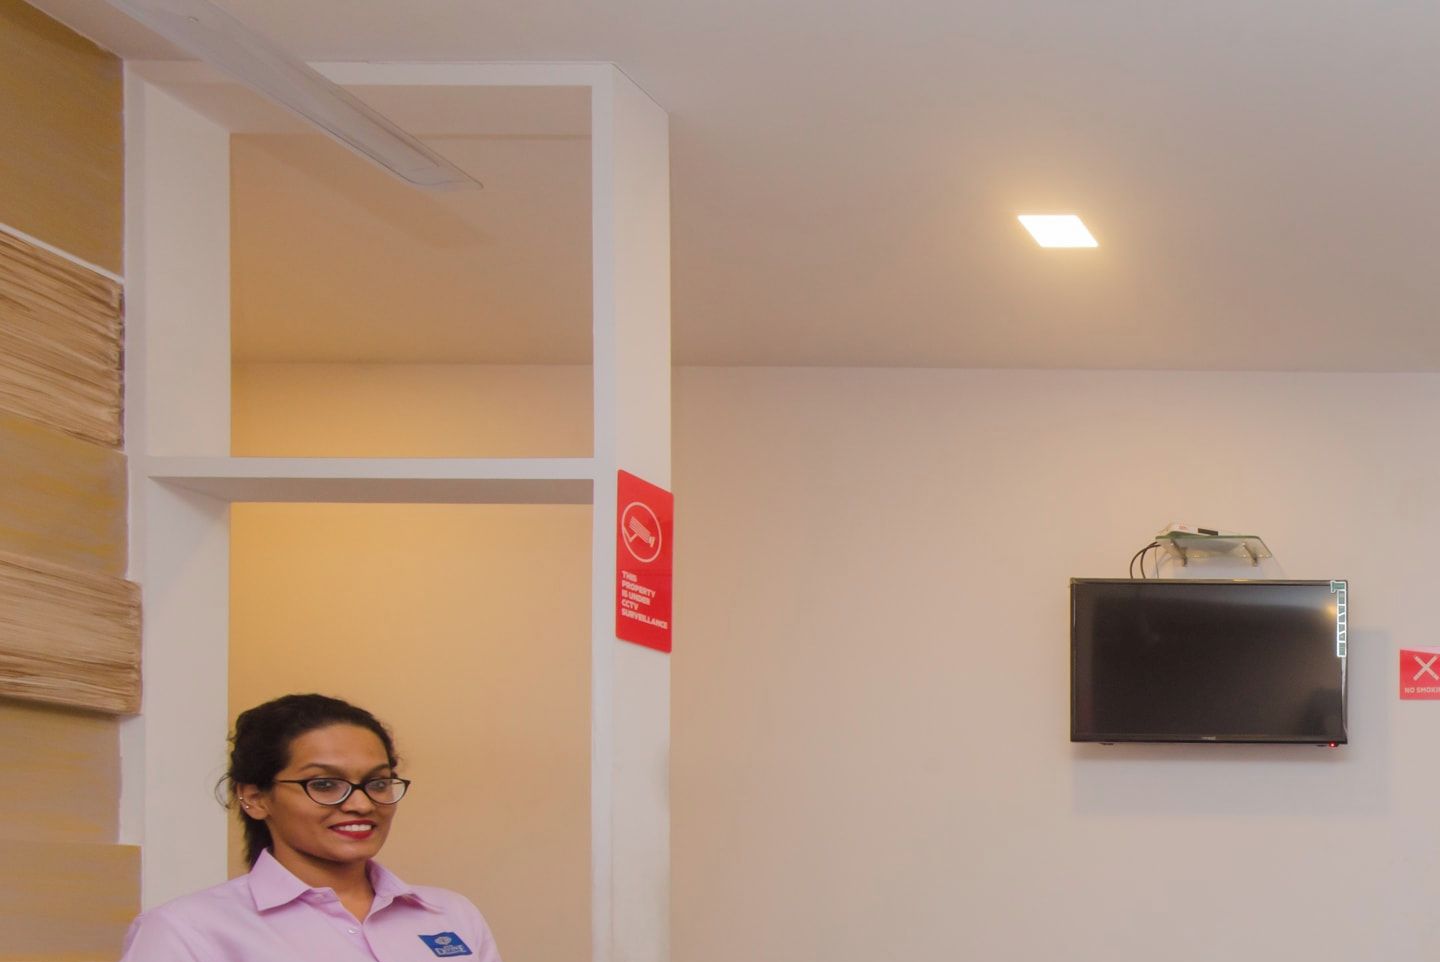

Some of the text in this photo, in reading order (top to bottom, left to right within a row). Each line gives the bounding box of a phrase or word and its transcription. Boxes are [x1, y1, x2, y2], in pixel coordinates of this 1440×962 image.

[622, 580, 656, 598] PROPERTY
[622, 598, 639, 610] CCTV
[622, 608, 668, 630] SURVEILLANCE
